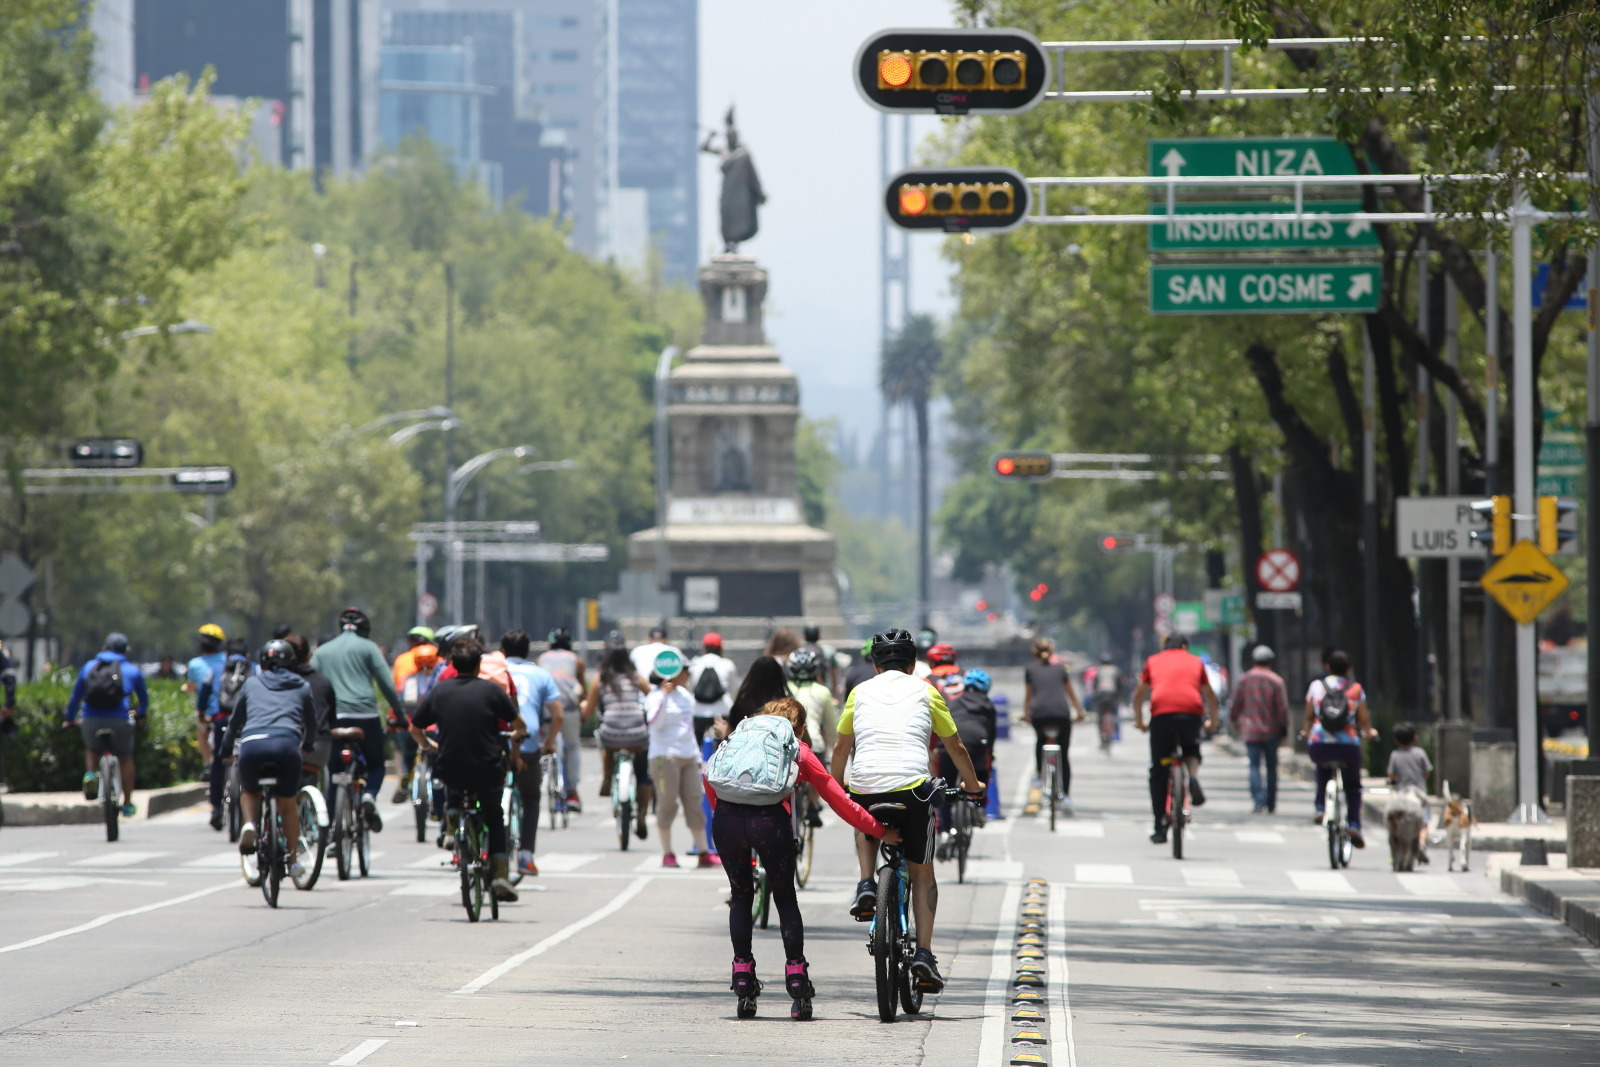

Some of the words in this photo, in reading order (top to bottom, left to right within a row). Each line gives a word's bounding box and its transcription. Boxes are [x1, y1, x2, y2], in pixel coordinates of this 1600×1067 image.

[1235, 148, 1324, 176] NIZA
[1166, 212, 1333, 241] INSURGENTES
[1168, 274, 1227, 304] SAN
[1239, 273, 1335, 302] COSME
[1411, 528, 1459, 551] LUIS
